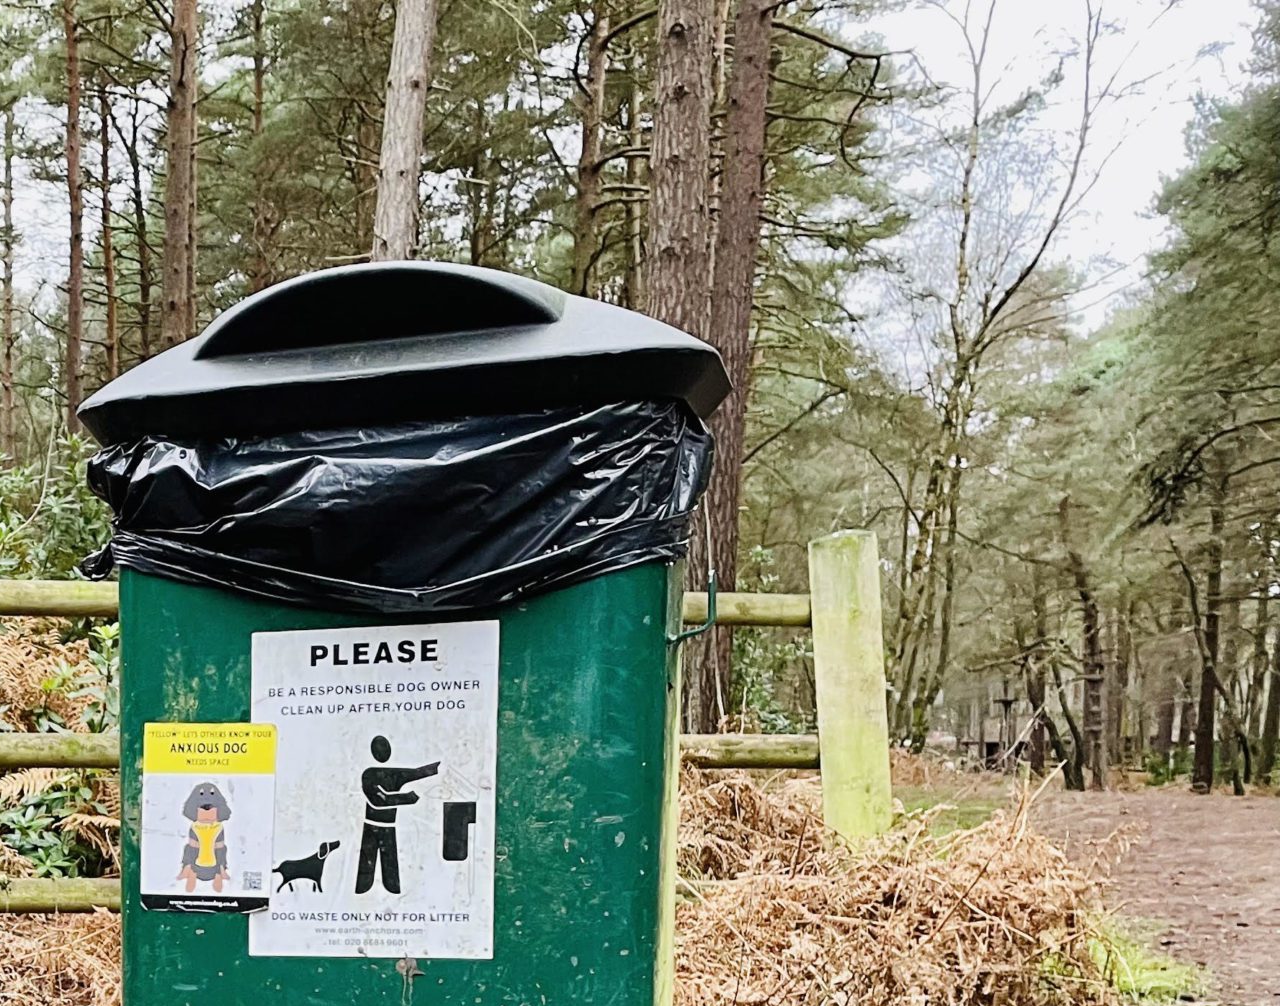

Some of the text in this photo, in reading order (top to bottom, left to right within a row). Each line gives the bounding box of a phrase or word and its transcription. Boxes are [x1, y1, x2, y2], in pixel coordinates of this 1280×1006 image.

[310, 639, 438, 667] PLEASE
[268, 680, 480, 698] BE A RESPONSIBLE DOG OWNER
[281, 699, 466, 715] CLEAN UP AFTER YOUR DOG
[170, 743, 248, 754] ANXIOUS DOG
[186, 758, 230, 766] NEEDS SPACE
[271, 912, 470, 922] DOG WASTE ONLY NOT FOR LITTER
